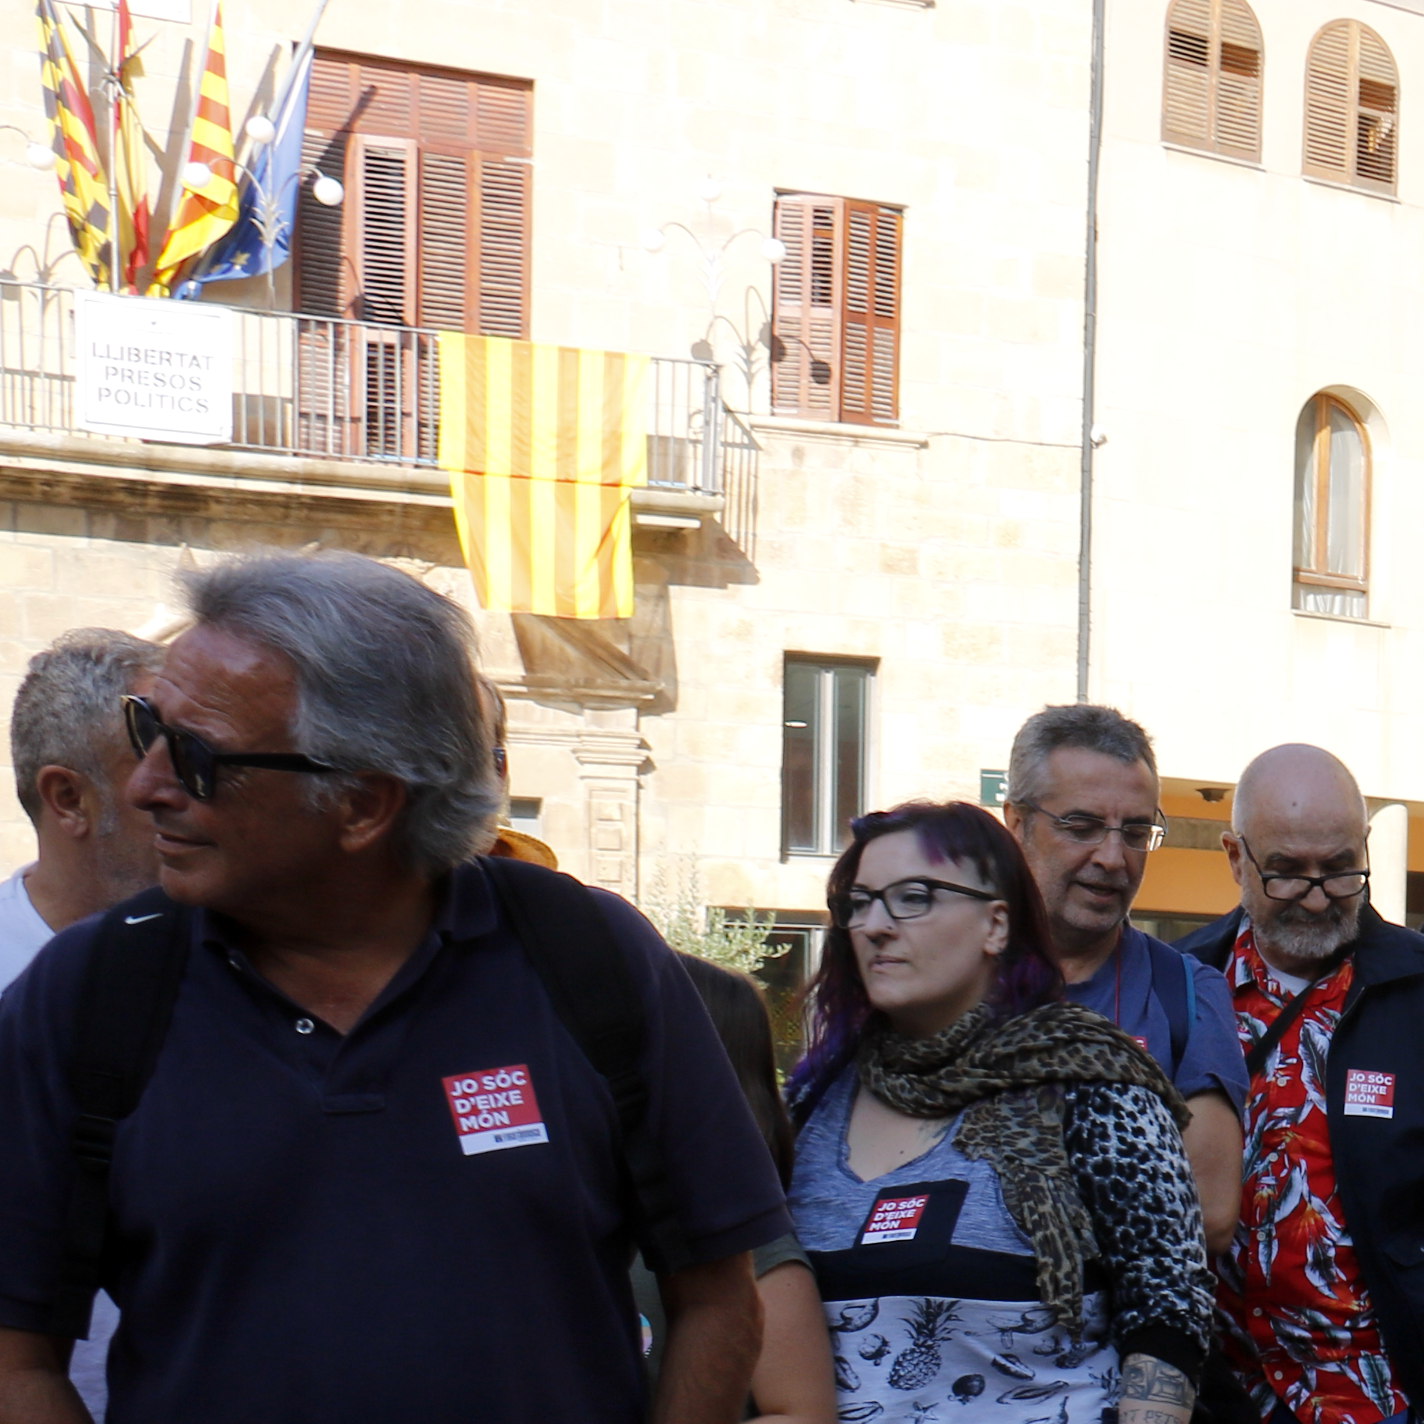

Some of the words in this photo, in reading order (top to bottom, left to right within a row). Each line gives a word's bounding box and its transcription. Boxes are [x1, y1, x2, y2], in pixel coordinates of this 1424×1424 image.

[92, 342, 215, 370] LLIBERTAT
[105, 365, 202, 392] PRESOS
[98, 386, 209, 414] POLITICS
[450, 1079, 479, 1097] JO
[481, 1069, 527, 1091] SÓC
[1349, 1083, 1387, 1095] D'EIXE
[1350, 1073, 1366, 1082] JO
[1367, 1073, 1393, 1086] SÓC
[453, 1089, 524, 1114] D'EIXE
[873, 1209, 917, 1222] D'EIXE
[877, 1202, 897, 1212] JO
